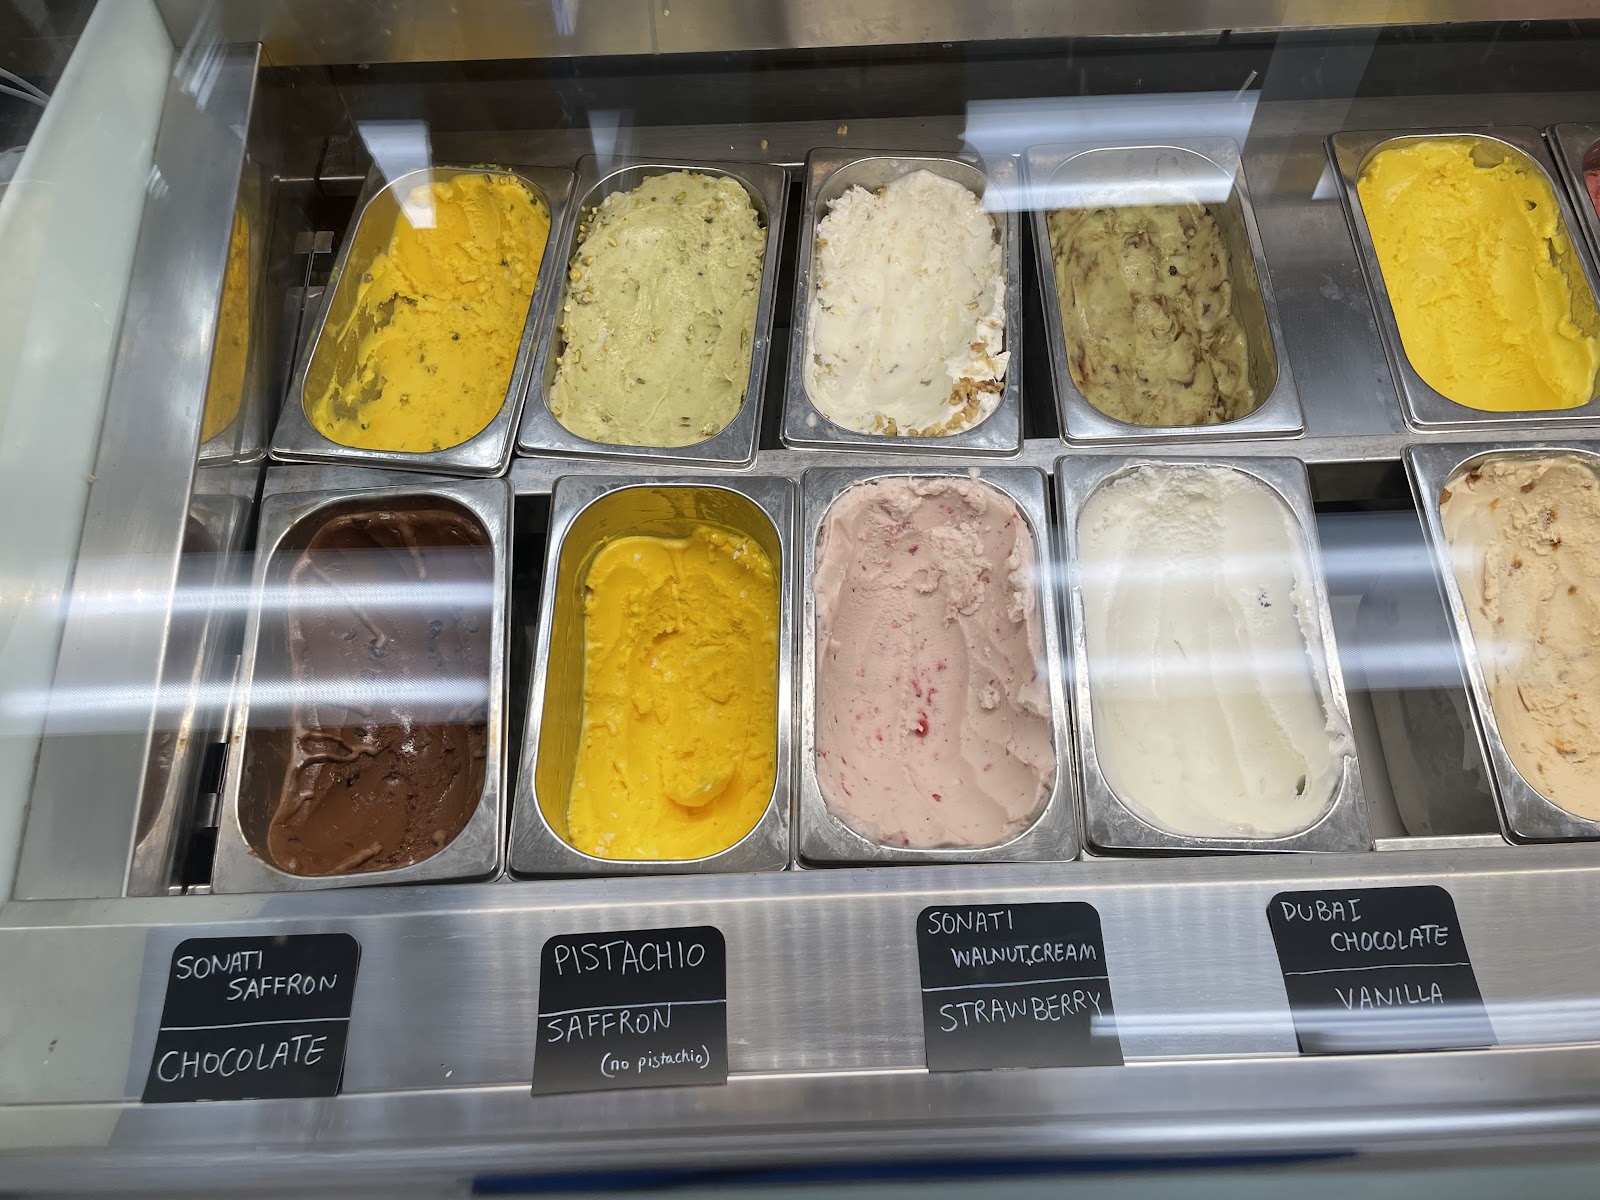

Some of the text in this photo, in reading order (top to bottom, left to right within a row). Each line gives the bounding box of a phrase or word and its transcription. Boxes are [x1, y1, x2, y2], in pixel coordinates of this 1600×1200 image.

[928, 909, 1013, 934] SONATI
[1280, 898, 1362, 922] DUBAI
[1330, 924, 1449, 951] CHOCOLATE
[176, 950, 263, 979] SONATI
[554, 941, 706, 975] PISTACHIO
[226, 973, 337, 1001] SAFFRON
[1335, 982, 1444, 1010] VANILLA
[547, 1002, 672, 1043] SAFFRON
[939, 989, 1103, 1032] STRAWBERRY
[157, 1034, 328, 1082] CHOCOLATE
[601, 1044, 711, 1078] (no pistachio)
